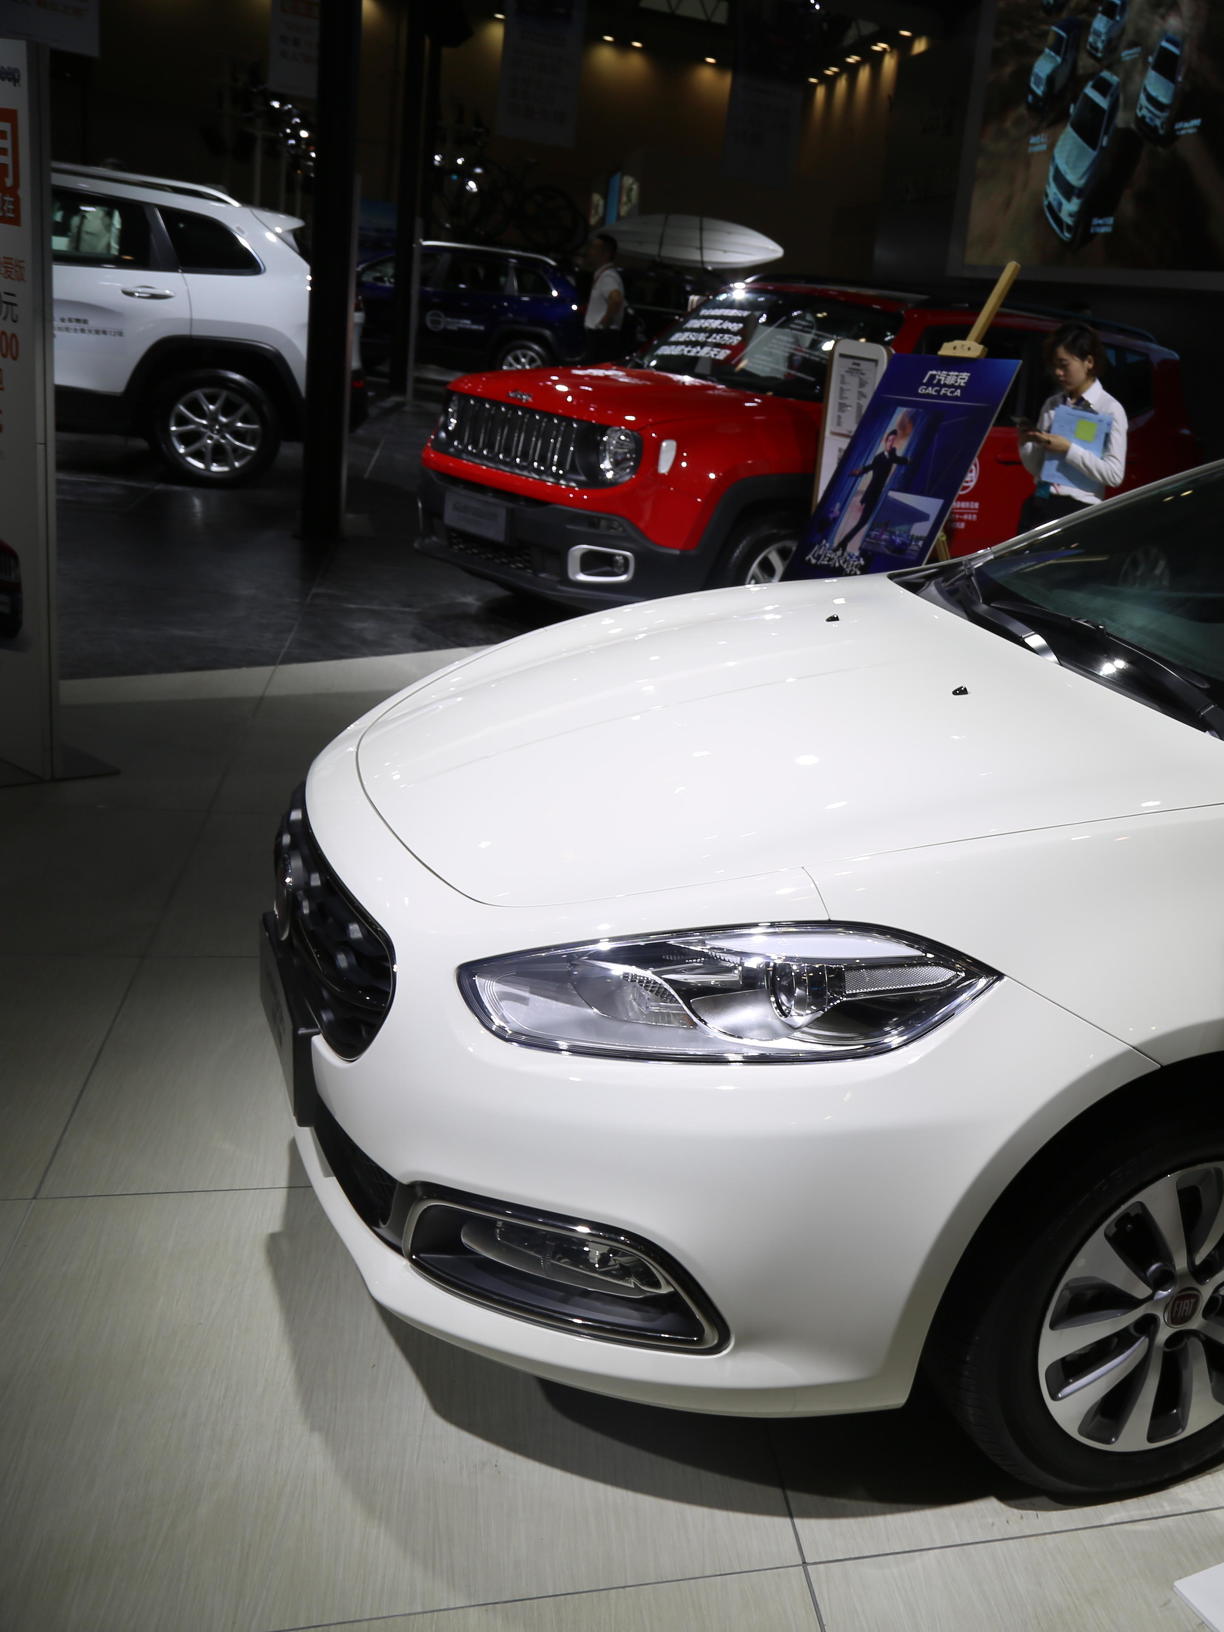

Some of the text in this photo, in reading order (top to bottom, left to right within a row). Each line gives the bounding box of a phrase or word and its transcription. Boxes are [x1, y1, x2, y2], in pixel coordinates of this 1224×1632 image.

[922, 370, 970, 386] 广汽菲克
[918, 386, 961, 397] GAC FCA
[1172, 1297, 1197, 1318] FIAT
